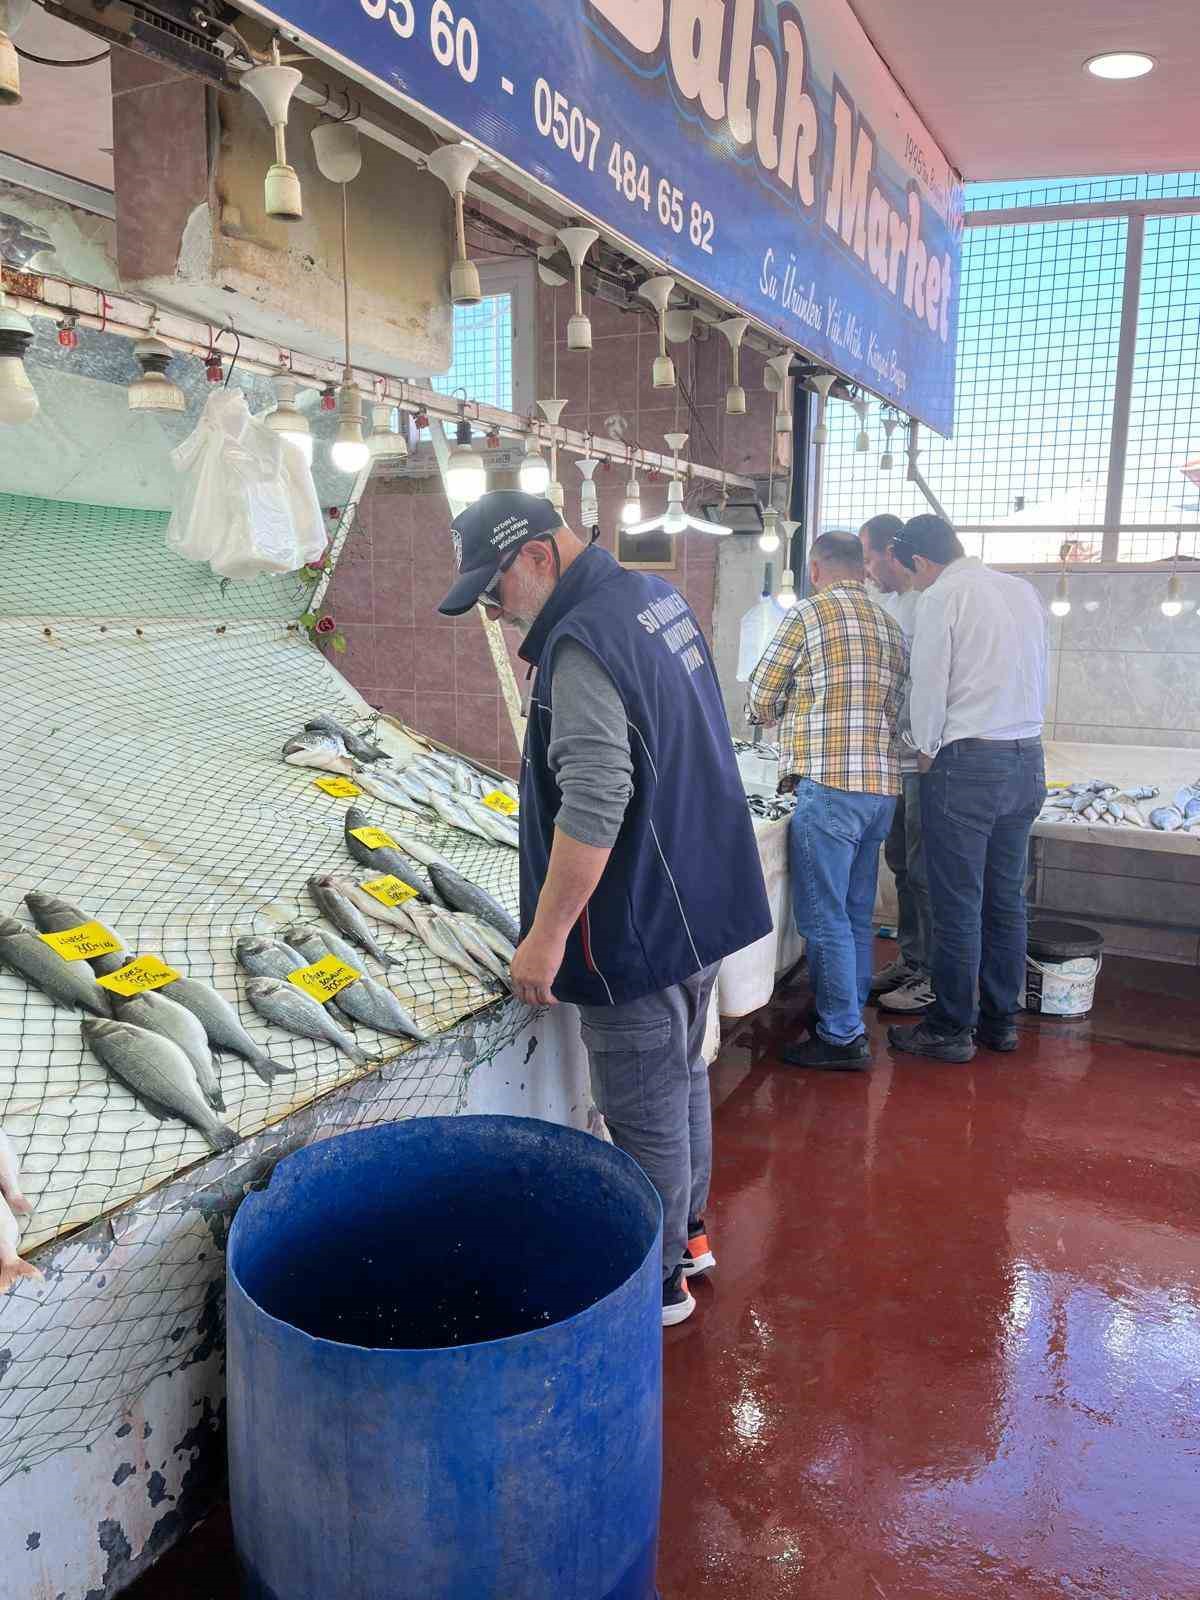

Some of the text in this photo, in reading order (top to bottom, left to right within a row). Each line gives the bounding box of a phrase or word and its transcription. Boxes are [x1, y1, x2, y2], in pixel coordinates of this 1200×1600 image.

[360, 0, 415, 39] 5
[431, 0, 479, 83] 60
[534, 77, 601, 171] 0507
[608, 141, 651, 212] 484
[657, 178, 684, 233] 65
[690, 201, 715, 255] 82
[759, 247, 778, 300] Su
[782, 252, 823, 331] Ürünleri
[825, 88, 951, 343] Market
[637, 608, 660, 634] SU
